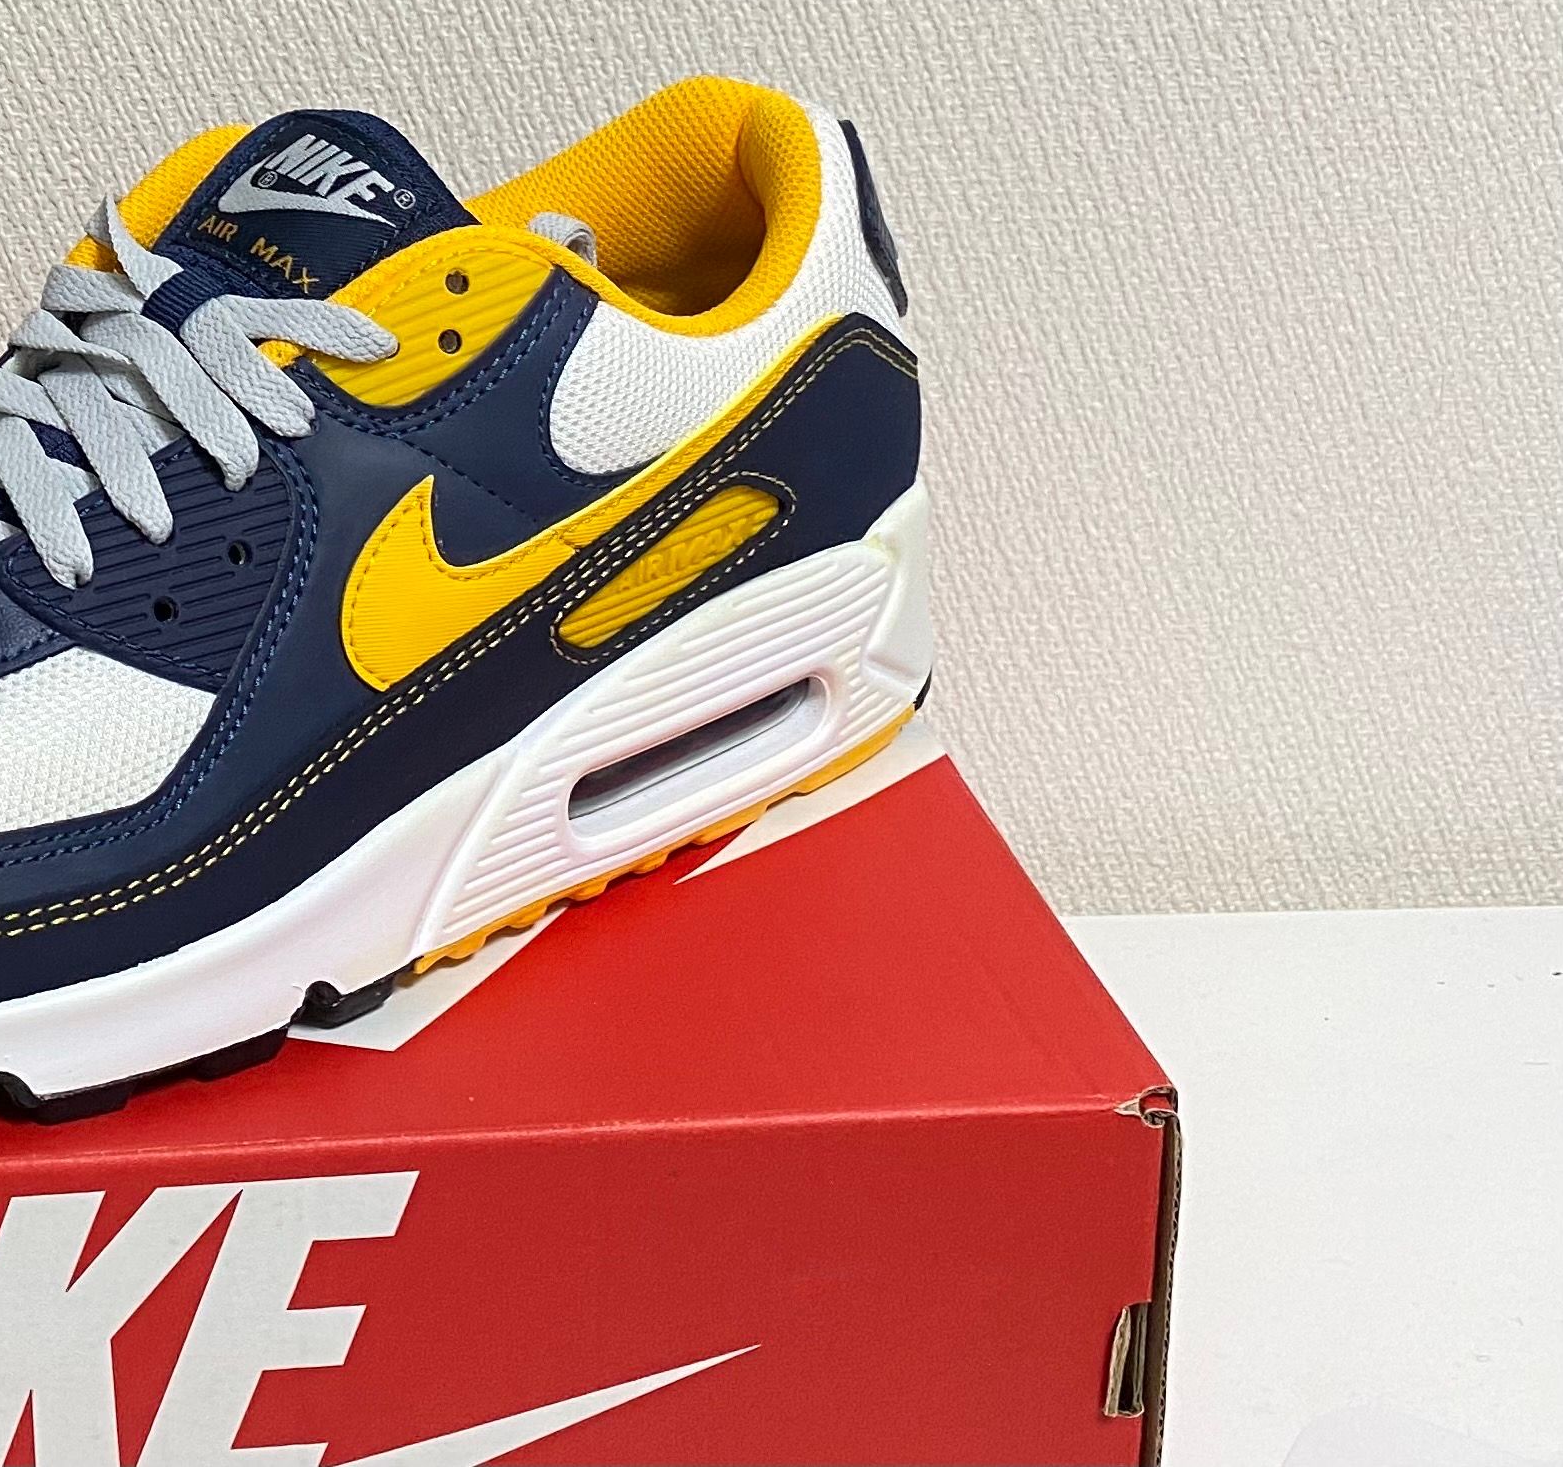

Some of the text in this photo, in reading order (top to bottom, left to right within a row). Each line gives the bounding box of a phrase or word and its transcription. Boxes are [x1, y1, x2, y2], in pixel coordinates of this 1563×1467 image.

[263, 133, 395, 201] NIKE
[197, 214, 320, 294] AIR MAX
